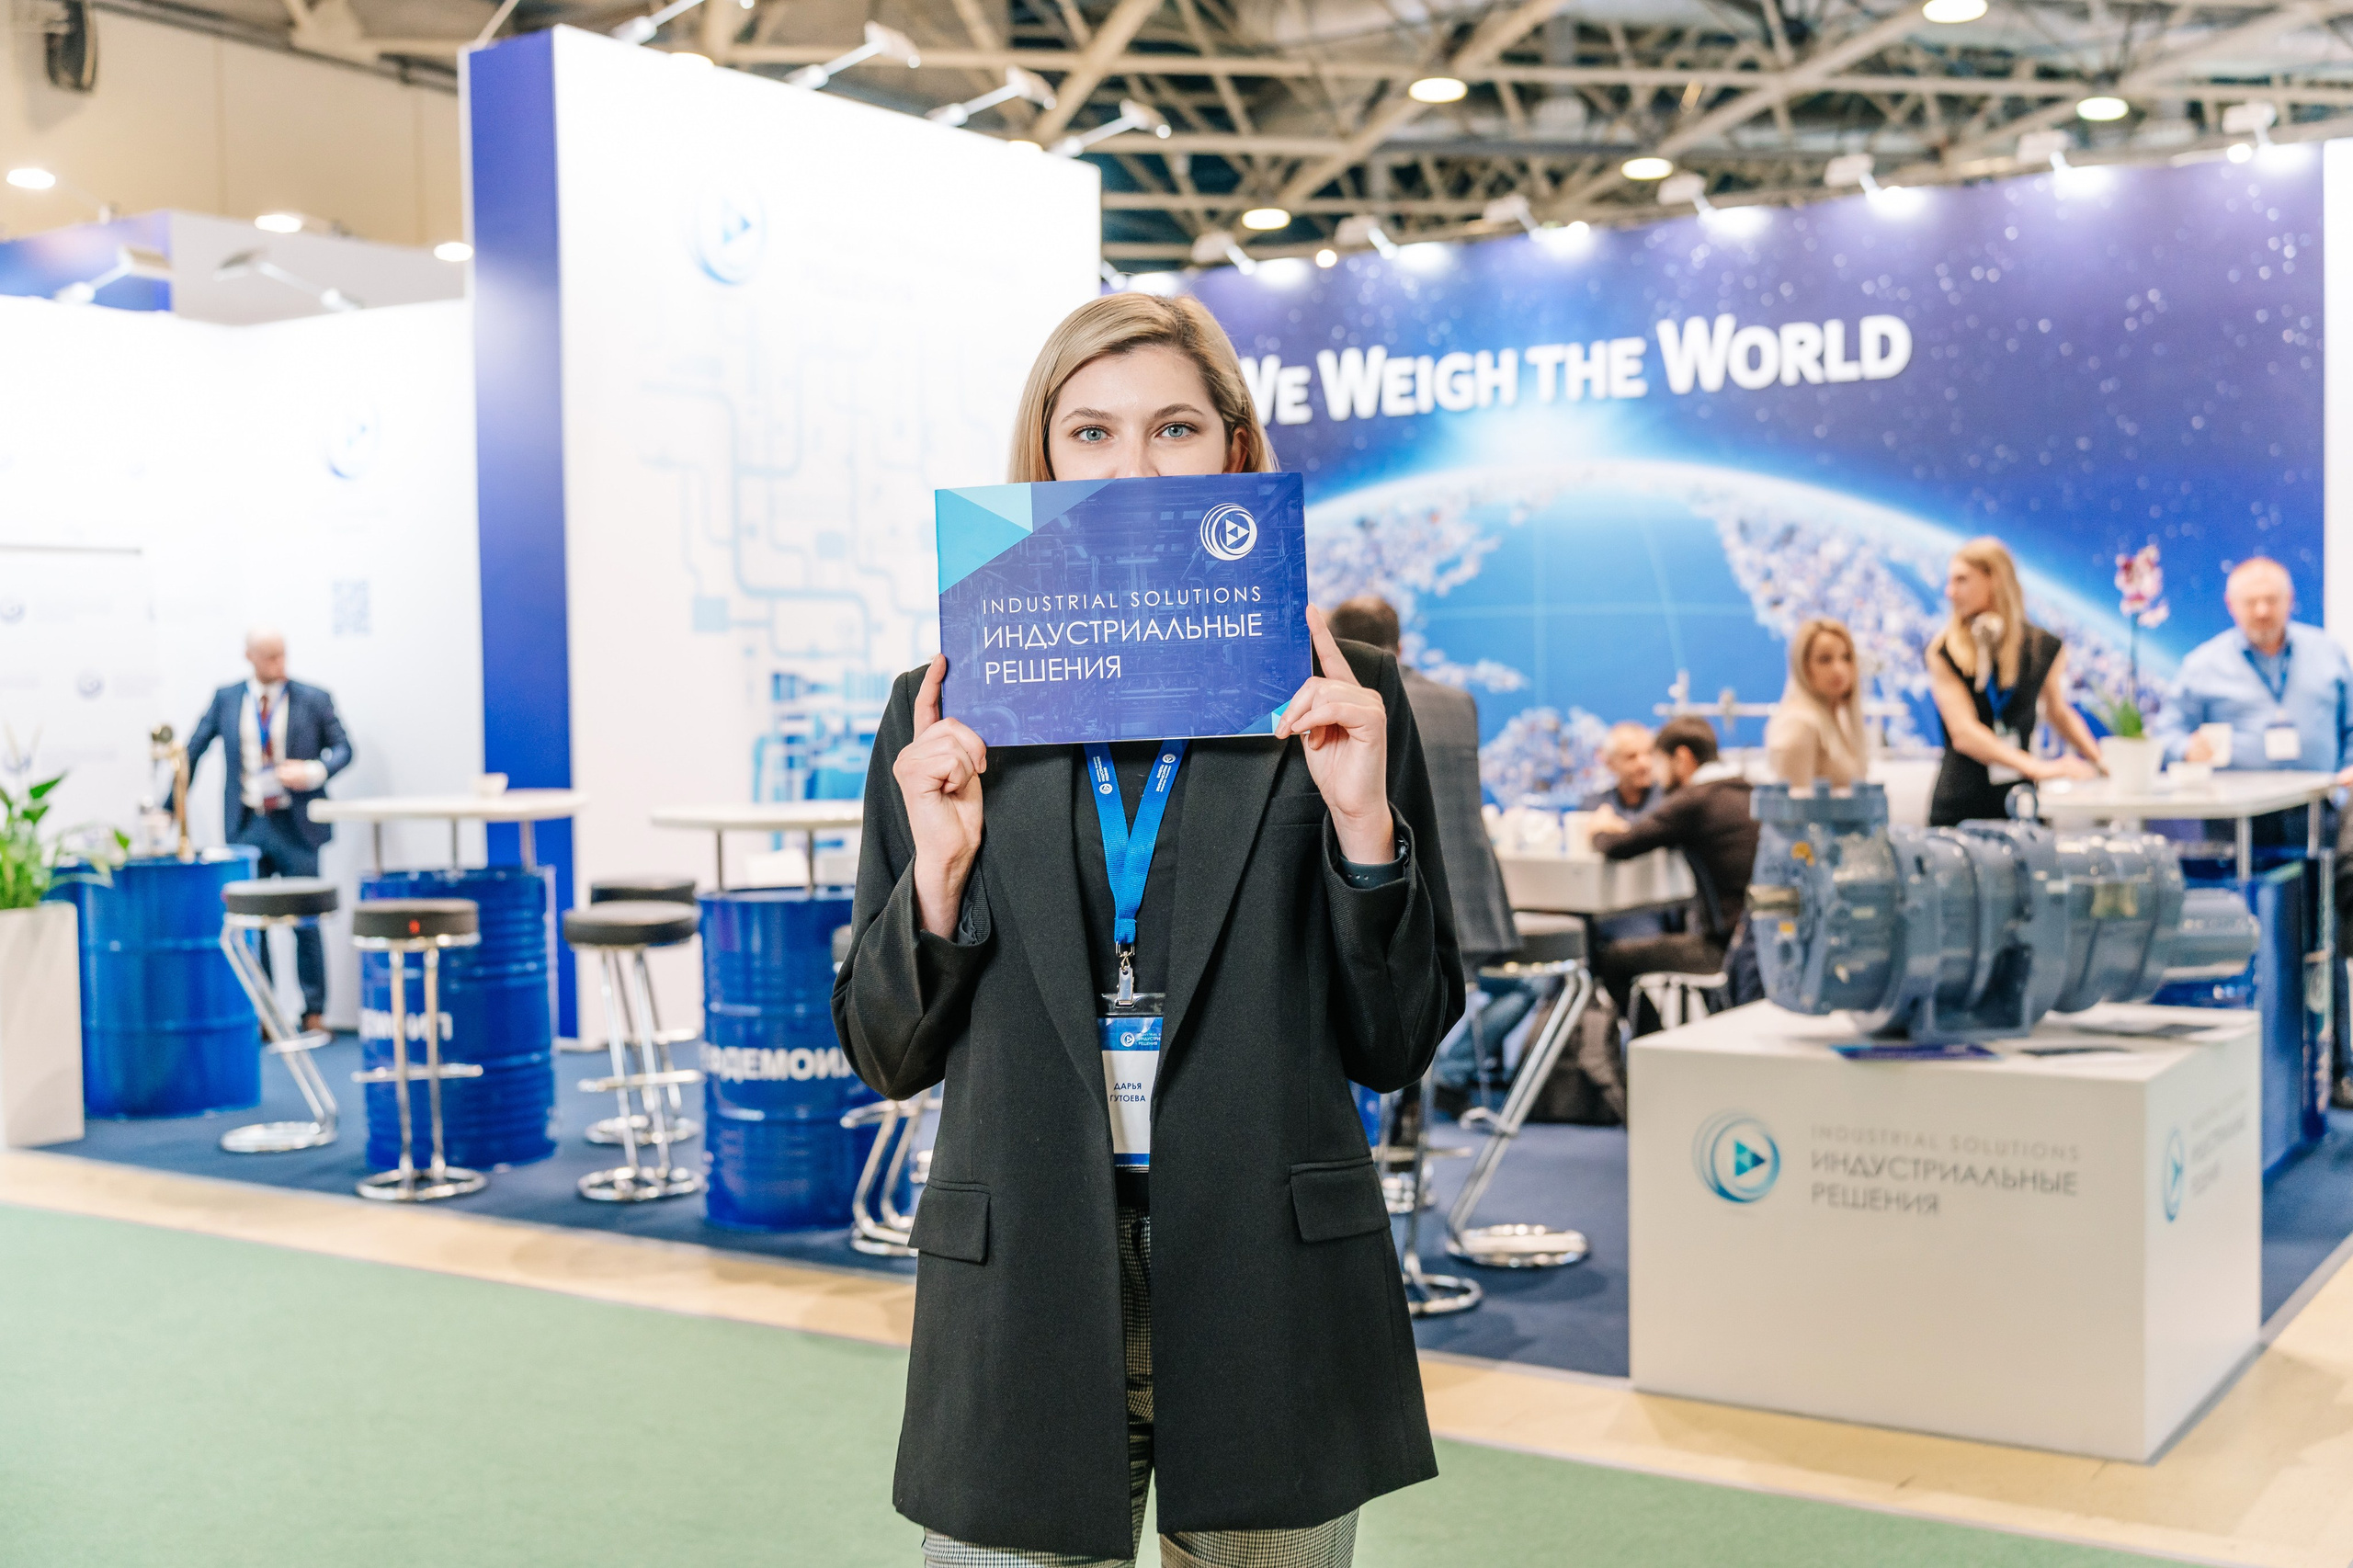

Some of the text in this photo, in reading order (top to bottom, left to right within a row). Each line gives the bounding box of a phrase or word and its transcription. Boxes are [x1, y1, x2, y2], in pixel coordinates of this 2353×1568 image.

[1316, 344, 1518, 422] WEIGH
[1526, 336, 1647, 403] THE
[1657, 313, 1913, 395] WORLD
[983, 585, 1262, 614] INDUSTRIAL SOLUTIONS
[983, 613, 1263, 650] ИНДУСТРИАЛЬНЫЕ
[984, 654, 1121, 685] РЕШЕНИЯ
[1113, 1082, 1142, 1090] ДАРЬЯ
[1811, 1150, 2078, 1197] ИНДУСТРИАЛЬНЫЕ
[1811, 1182, 1941, 1214] РЕШЕНИЯ
